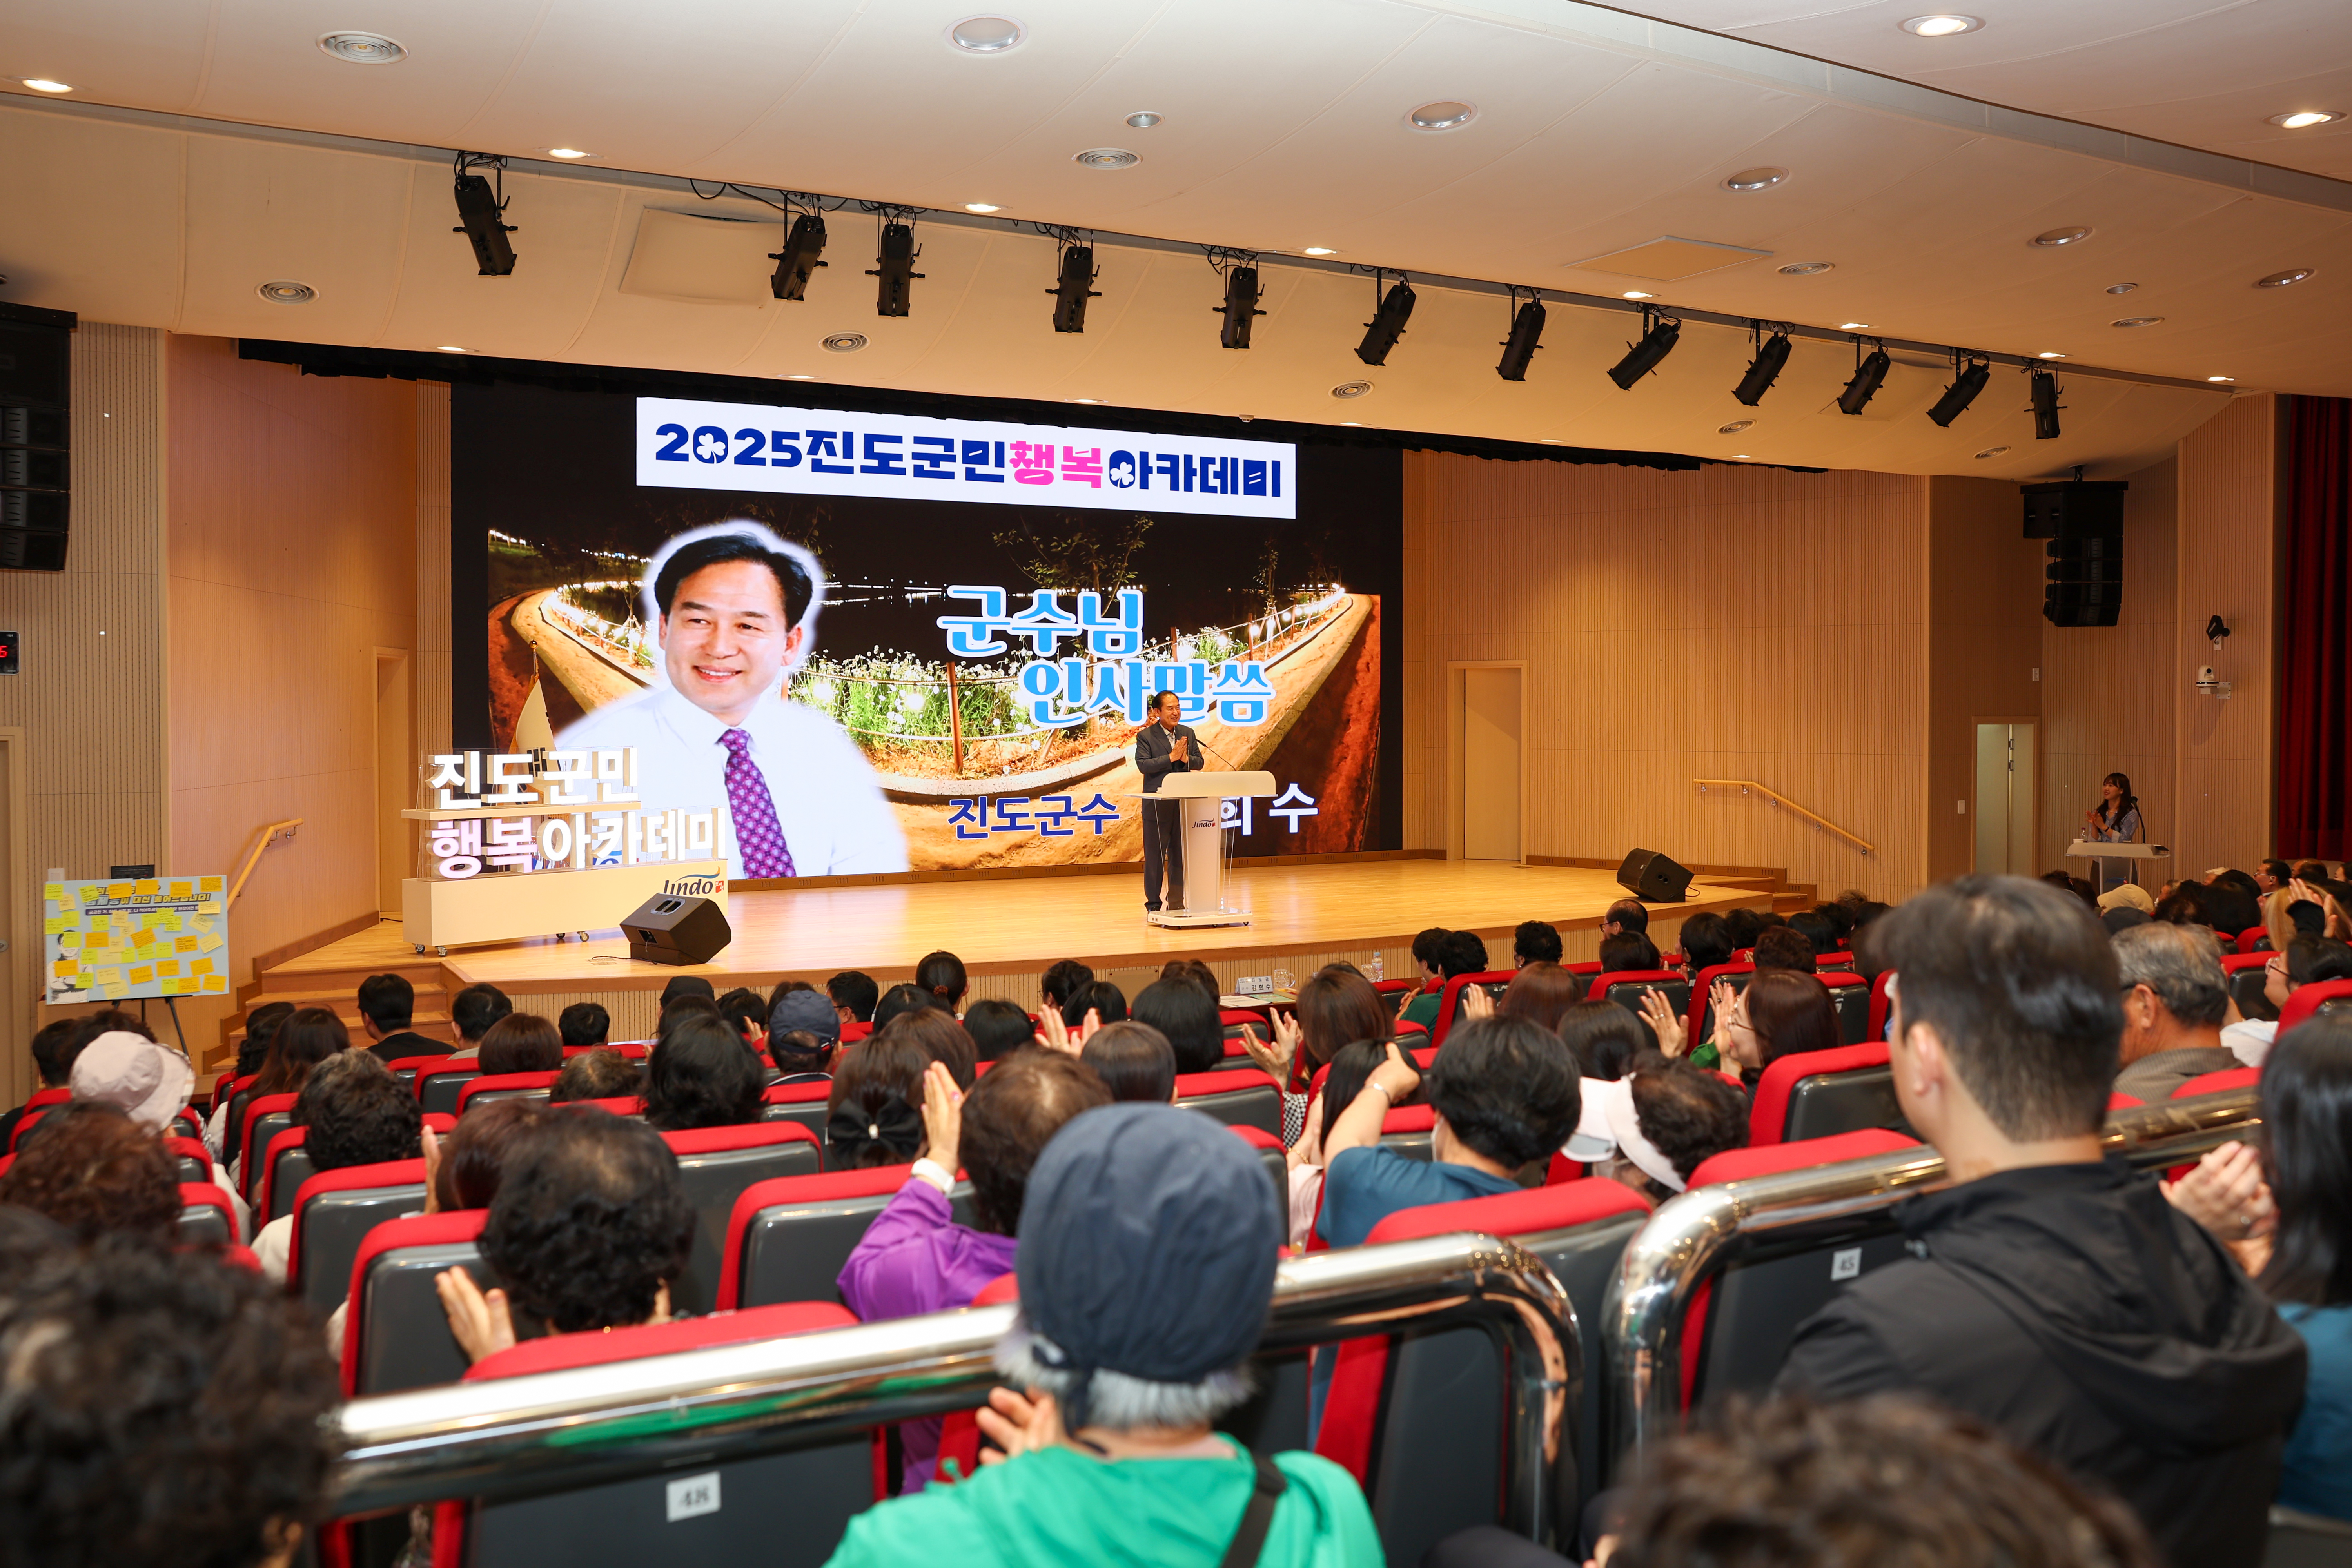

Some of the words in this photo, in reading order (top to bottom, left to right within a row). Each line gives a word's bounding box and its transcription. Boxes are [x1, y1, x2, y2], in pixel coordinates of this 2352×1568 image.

[939, 587, 1142, 657] 군수님
[1020, 659, 1274, 726] 인사말씀
[428, 748, 639, 809] 진도군민
[948, 793, 1120, 839] 진도군수
